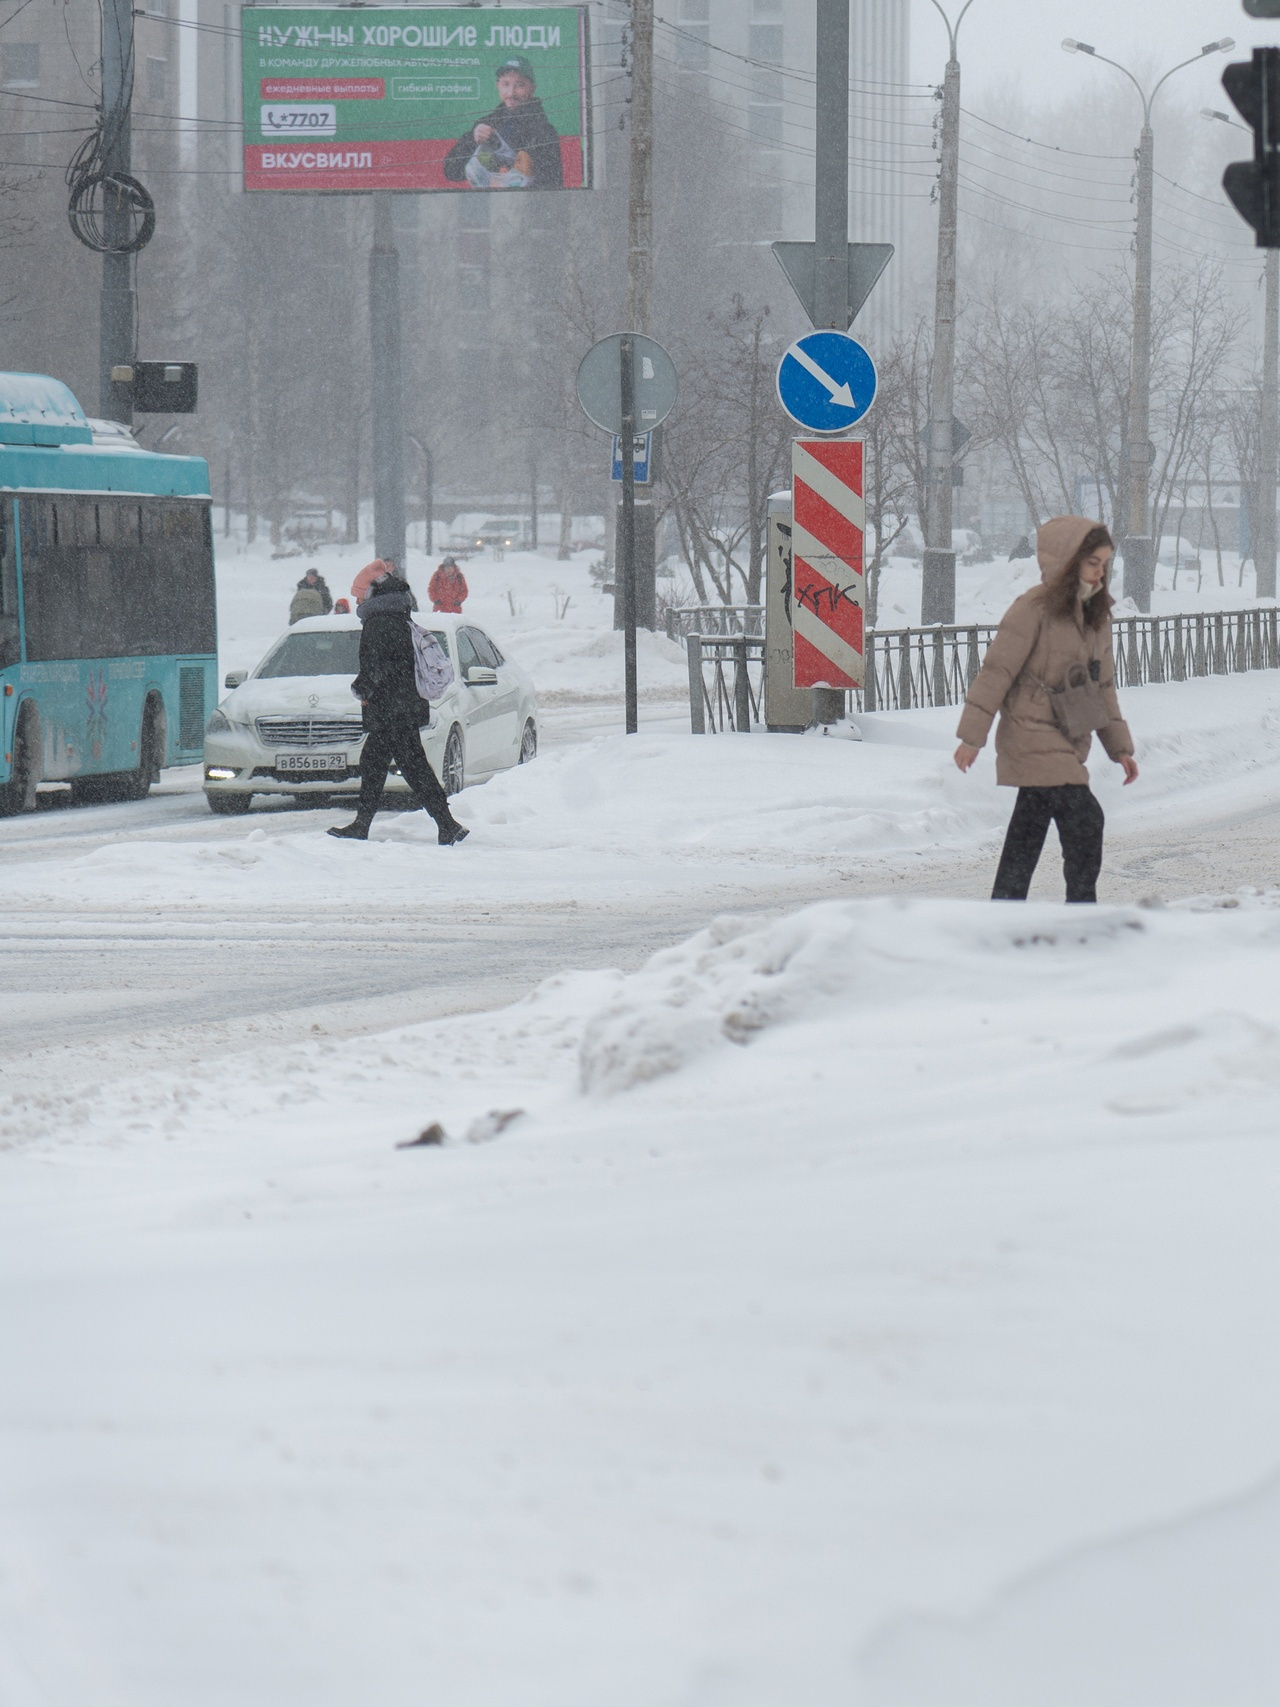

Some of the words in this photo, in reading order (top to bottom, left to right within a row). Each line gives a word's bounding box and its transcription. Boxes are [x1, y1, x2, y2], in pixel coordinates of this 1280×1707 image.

[259, 26, 354, 47] НУЖНЫ
[485, 26, 561, 50] ЛЮДИ
[259, 58, 266, 67] В
[268, 58, 319, 68] КОМАНДУ
[321, 58, 402, 68] ДРУЖЕЛЮБНЫХ
[266, 84, 332, 94] ежедневные
[334, 85, 379, 93] выплаты
[398, 83, 434, 93] гибкий
[436, 84, 473, 94] график
[261, 152, 372, 169] ВКУСВИЛЛ
